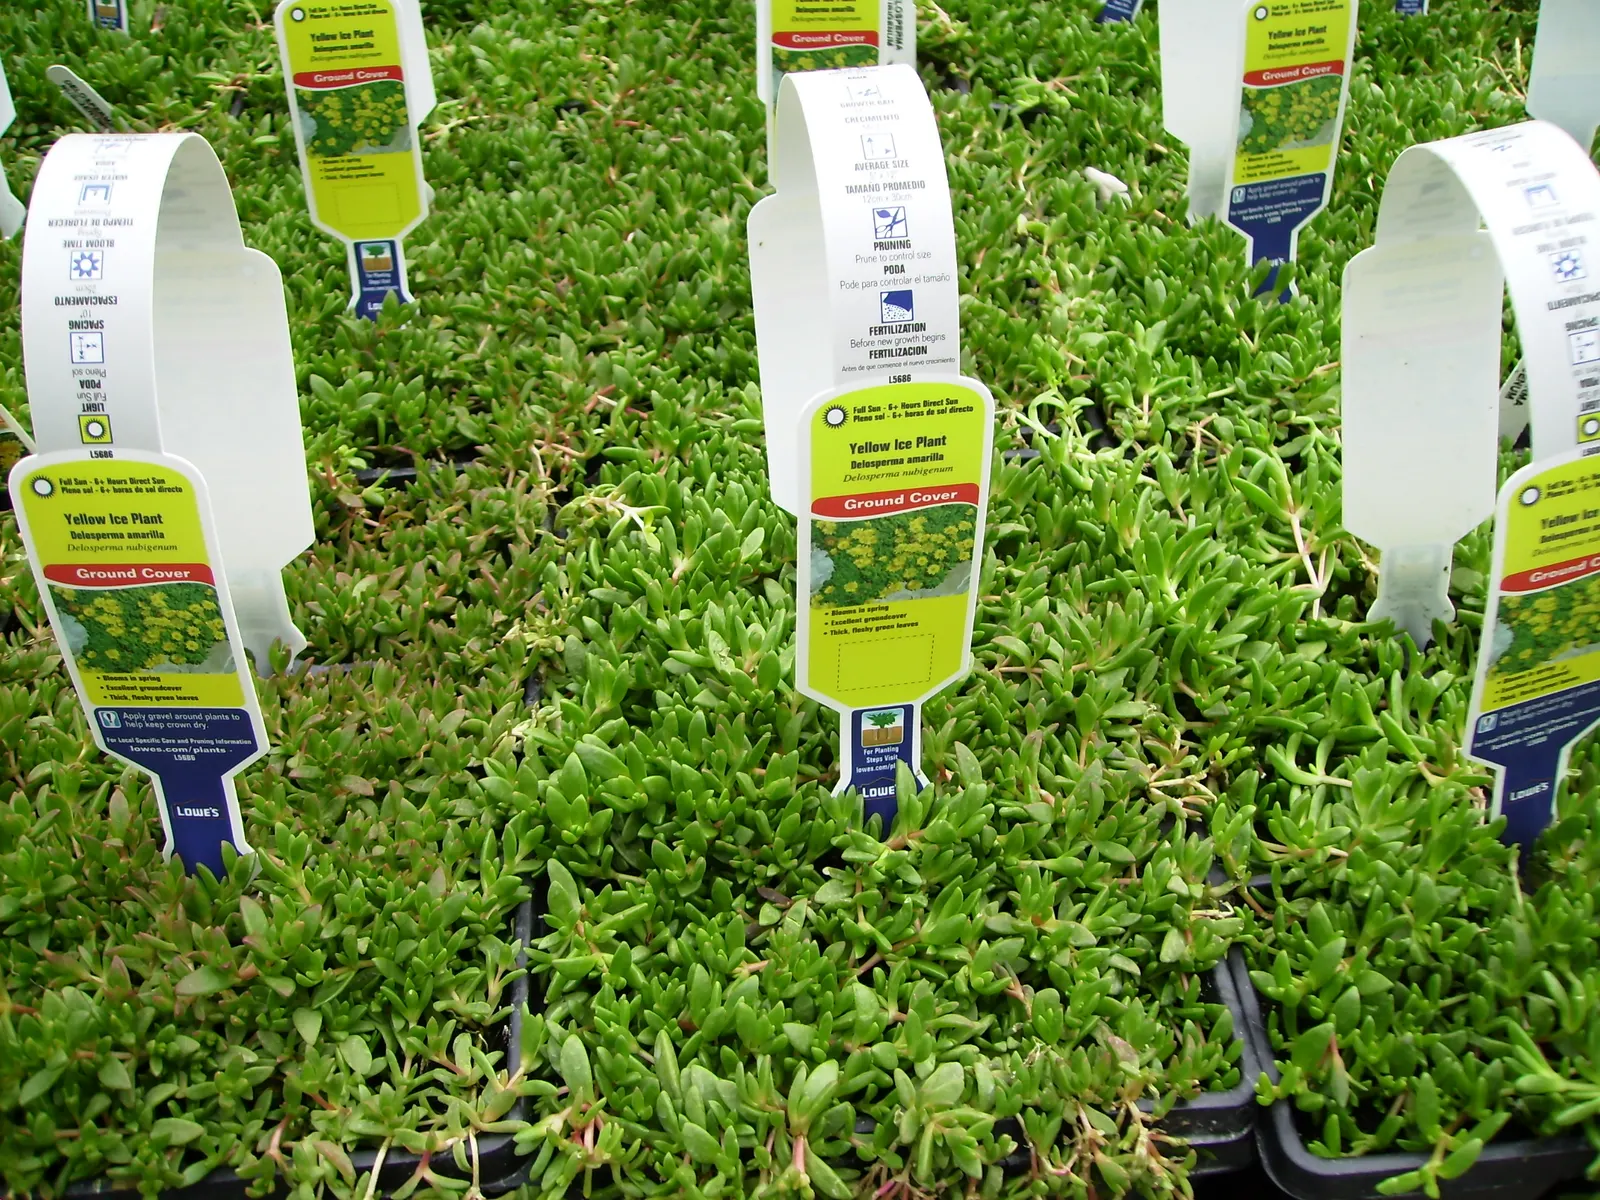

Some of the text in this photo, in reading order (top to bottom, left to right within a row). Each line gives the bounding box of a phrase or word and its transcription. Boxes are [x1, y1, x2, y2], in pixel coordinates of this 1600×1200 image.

[792, 34, 866, 43] Ground Cover
[314, 70, 389, 83] Ground Cover
[1262, 65, 1332, 81] Ground Cover
[854, 160, 910, 172] AVERAGE SIZE
[845, 180, 926, 194] TAMAÑO PROMEDIO
[48, 218, 134, 227] TIEMPO DE FLORECER
[62, 239, 115, 248] BLOOM TIME
[874, 240, 912, 252] PRUNING
[856, 251, 932, 264] Prune to control size
[884, 264, 906, 275] PODA
[840, 272, 950, 291] Pode para controlar el tamaño
[54, 295, 118, 306] ESPACIAMENTO
[69, 320, 104, 330] SPACING
[869, 322, 926, 336] FERTILIZATION
[850, 332, 946, 348] Before new growth begins
[869, 346, 928, 360] FERTILIZACION
[878, 361, 902, 369] comience
[926, 357, 956, 366] crecimiento
[72, 368, 106, 378] Pleno sol
[889, 374, 912, 384] L5686
[79, 379, 102, 389] PODA
[77, 392, 106, 402] Full Sun
[82, 402, 104, 412] LIGHT
[853, 406, 866, 414] Full
[868, 404, 882, 412] Sun
[901, 401, 922, 410] Hours
[923, 399, 944, 408] Direct
[946, 398, 959, 406] Sun
[853, 414, 873, 422] Pleno
[874, 413, 886, 421] sol
[892, 412, 903, 420] 6+
[904, 410, 924, 418] horas
[926, 408, 935, 416] de
[949, 405, 974, 414] directo
[849, 435, 948, 455] Yellow Ice Plant
[90, 450, 114, 458] L5686
[850, 452, 944, 470] Delosperma amarilla
[843, 466, 954, 483] Delosperma nubigenum
[59, 478, 73, 486] Full
[74, 478, 88, 486] Sun
[62, 486, 81, 494] Pleno
[82, 486, 94, 494] sol
[100, 486, 111, 494] 6+
[112, 486, 134, 494] horas
[844, 490, 959, 510] Ground Cover
[64, 512, 164, 525] Yellow Ice Plant
[70, 530, 165, 542] Delosperma amarilla
[67, 544, 178, 552] Delosperma nubigenum
[76, 568, 191, 580] Ground Cover
[1529, 560, 1588, 582] Ground
[832, 604, 890, 616] Blooms in spring
[831, 612, 908, 626] Excellent groundcover
[830, 620, 919, 636] Thick, fleshy green leaves
[132, 694, 154, 702] fleshy
[176, 694, 200, 702] leaves
[123, 712, 146, 722] Apply
[147, 712, 173, 722] gravel
[174, 712, 204, 720] around
[205, 713, 230, 722] plants
[125, 721, 144, 730] help
[146, 722, 166, 730] keep
[194, 722, 209, 730] dry.
[190, 738, 214, 746] Pruning
[130, 746, 227, 754] lowes.com/plants
[864, 746, 900, 756] For Planting
[866, 754, 898, 765] Steps Visit
[1510, 782, 1550, 801] LOWE'S
[176, 806, 220, 818] LOWE'S
